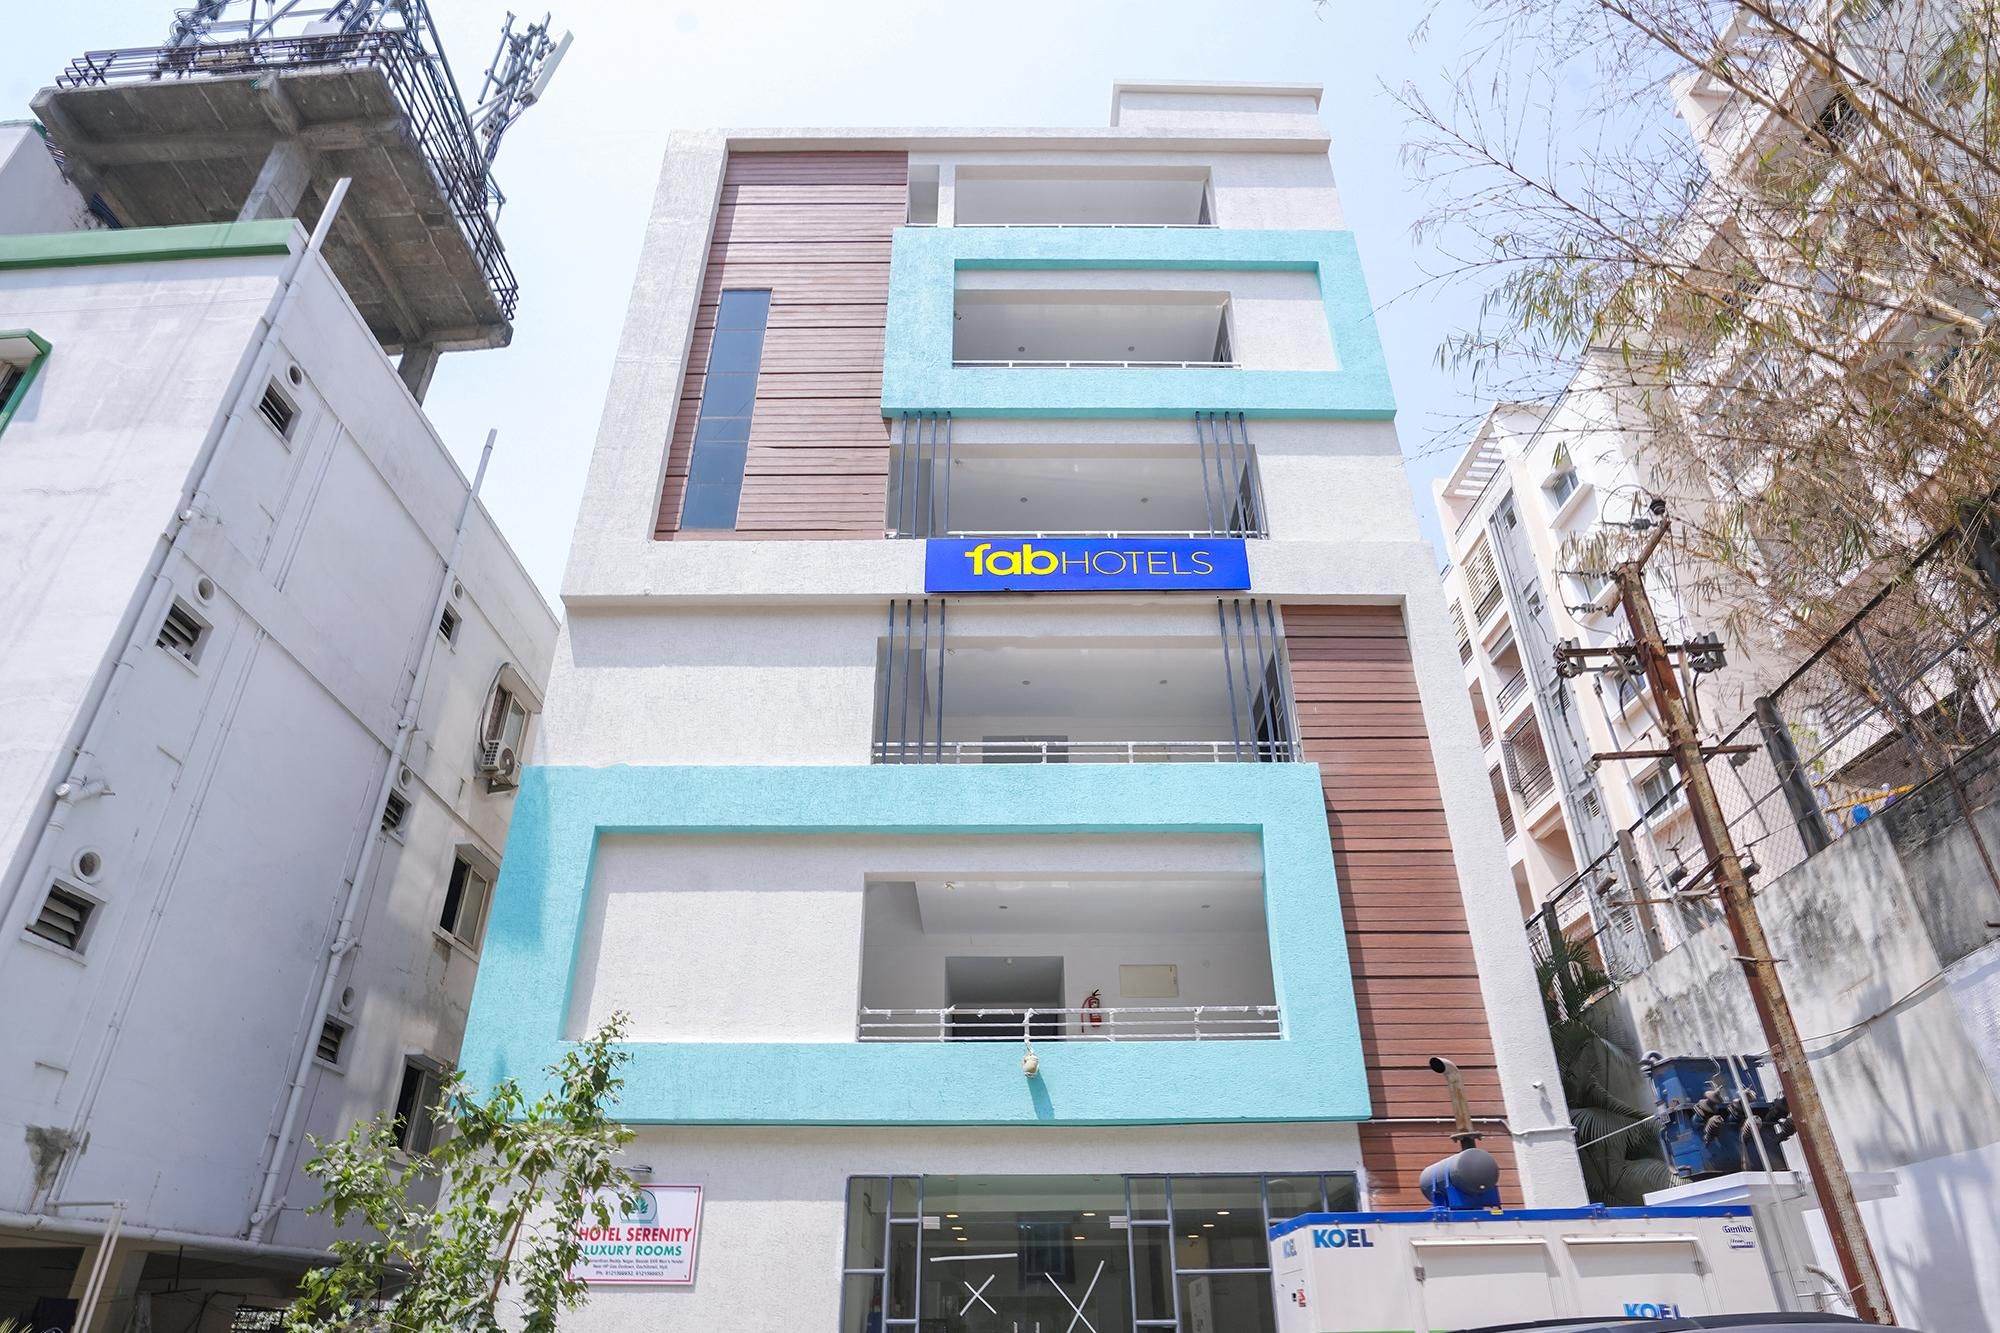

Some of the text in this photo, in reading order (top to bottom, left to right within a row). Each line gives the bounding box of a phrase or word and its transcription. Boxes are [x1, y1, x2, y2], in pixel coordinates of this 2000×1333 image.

[579, 1227, 693, 1242] HOTEL SERENITY
[1312, 1228, 1375, 1249] KOEL
[583, 1245, 683, 1257] LUXURY ROOMS
